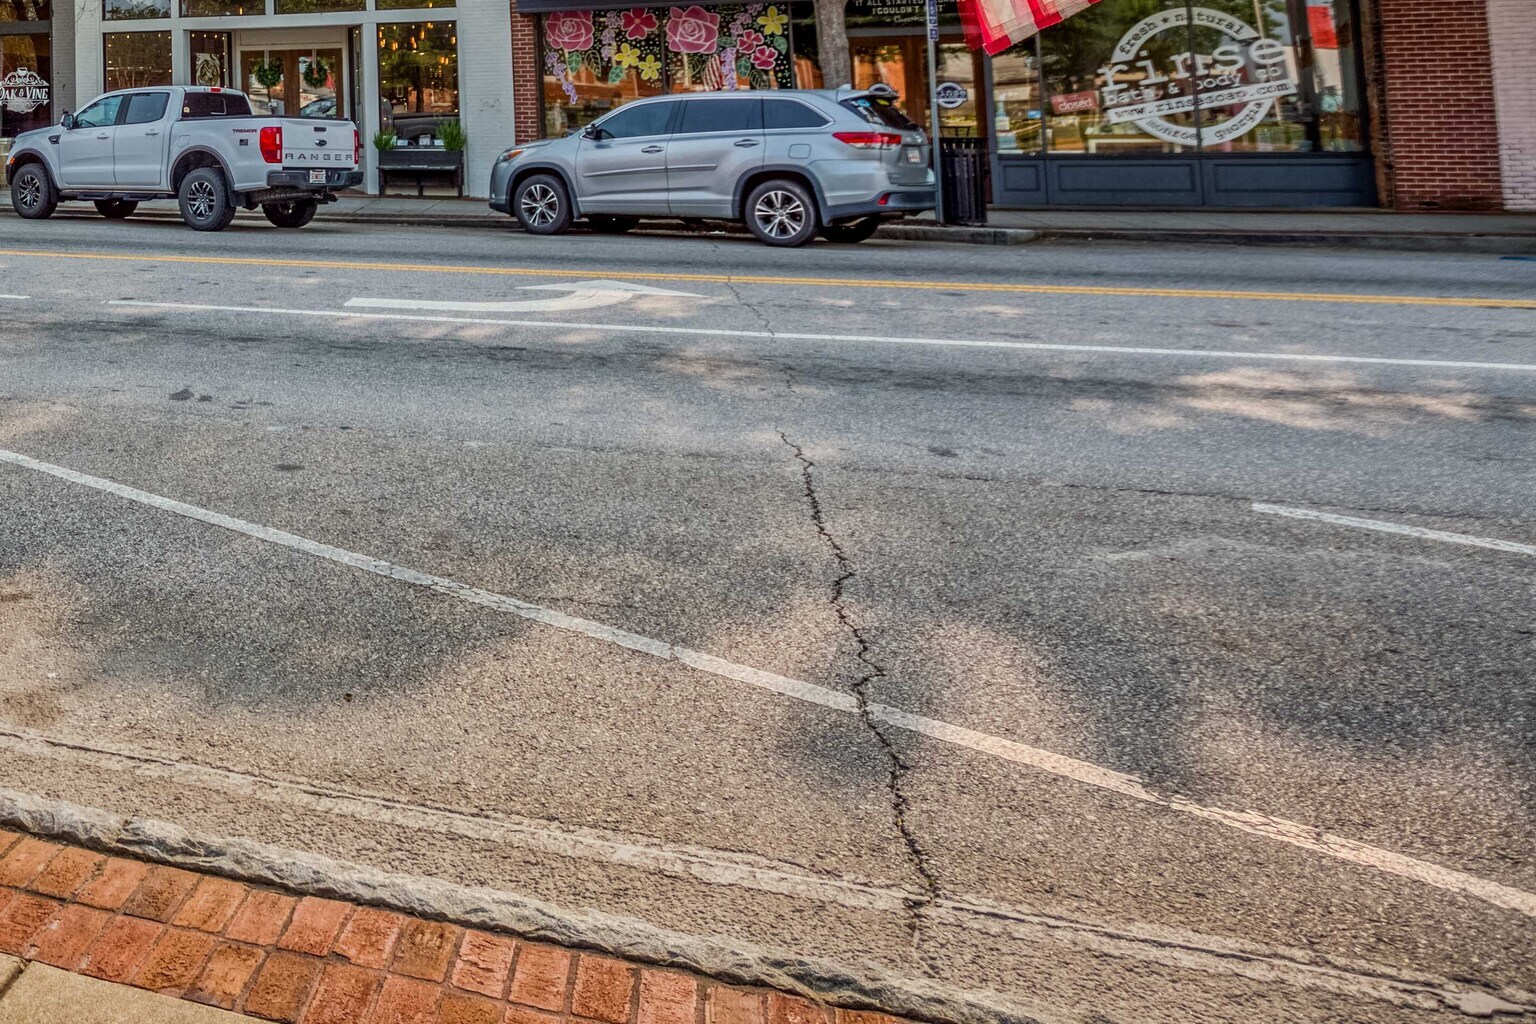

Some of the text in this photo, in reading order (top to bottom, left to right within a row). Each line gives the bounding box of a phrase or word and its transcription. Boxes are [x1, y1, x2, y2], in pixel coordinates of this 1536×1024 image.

[1119, 12, 1244, 55] fresh ntural
[1096, 37, 1286, 92] rinse
[19, 88, 24, 97] &
[26, 86, 49, 100] VINE
[1167, 82, 1180, 95] &
[1058, 97, 1093, 111] closed
[1214, 101, 1264, 140] georgia
[284, 153, 353, 161] RANGER
